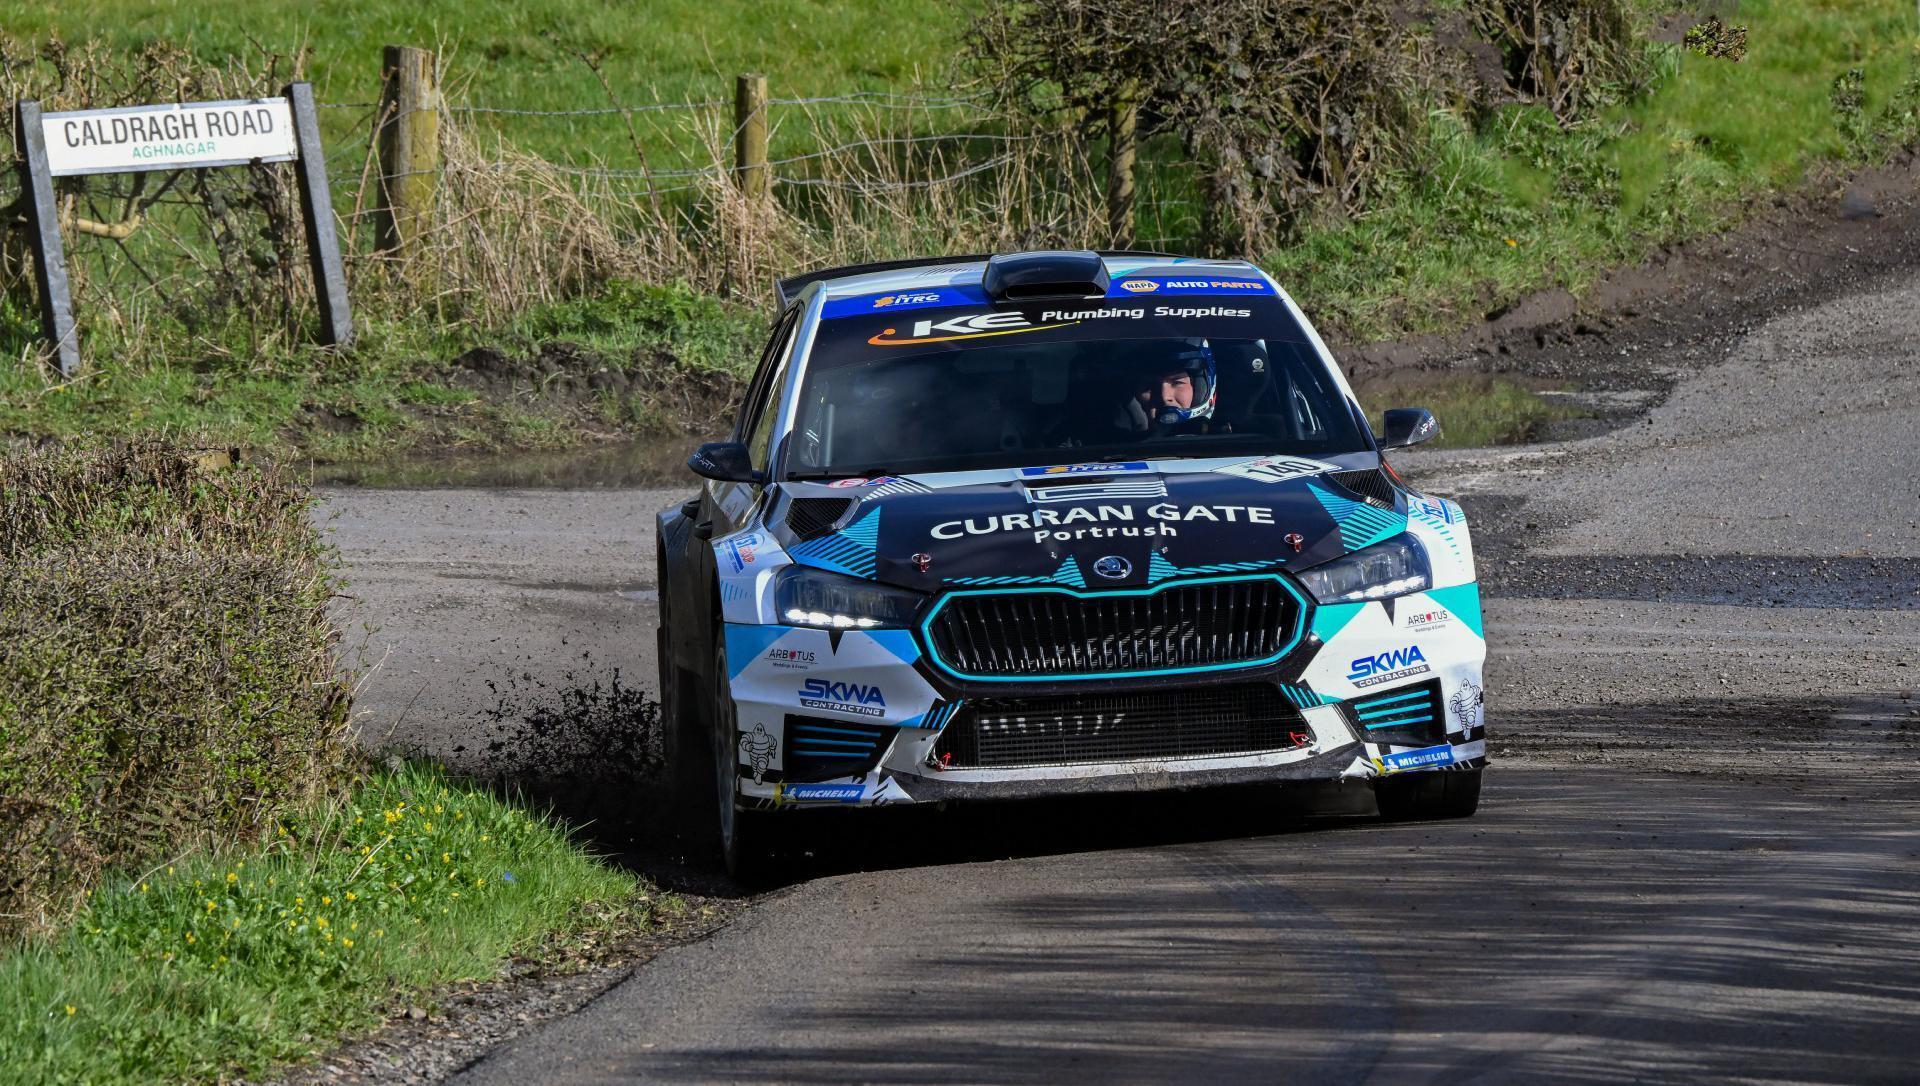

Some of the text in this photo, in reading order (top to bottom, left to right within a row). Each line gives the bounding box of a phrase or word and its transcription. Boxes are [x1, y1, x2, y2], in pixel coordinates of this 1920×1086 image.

[64, 108, 273, 148] CALDRAGH ROAD
[132, 141, 216, 159] AGHNAGAR
[1210, 281, 1264, 289] PARTS
[1041, 306, 1251, 321] Plumbing Supplies
[913, 311, 1032, 337] KE
[1247, 461, 1321, 478] 140
[930, 503, 1275, 540] CURRAN GATE
[1034, 522, 1177, 544] Portrush
[1346, 645, 1427, 680] SKWA
[1359, 665, 1427, 687] CONTRACTING
[798, 678, 886, 706] SKWA
[805, 700, 881, 715] CONTRACTING
[1398, 750, 1450, 767] MICHELIN
[798, 789, 860, 798] MICHELIN
